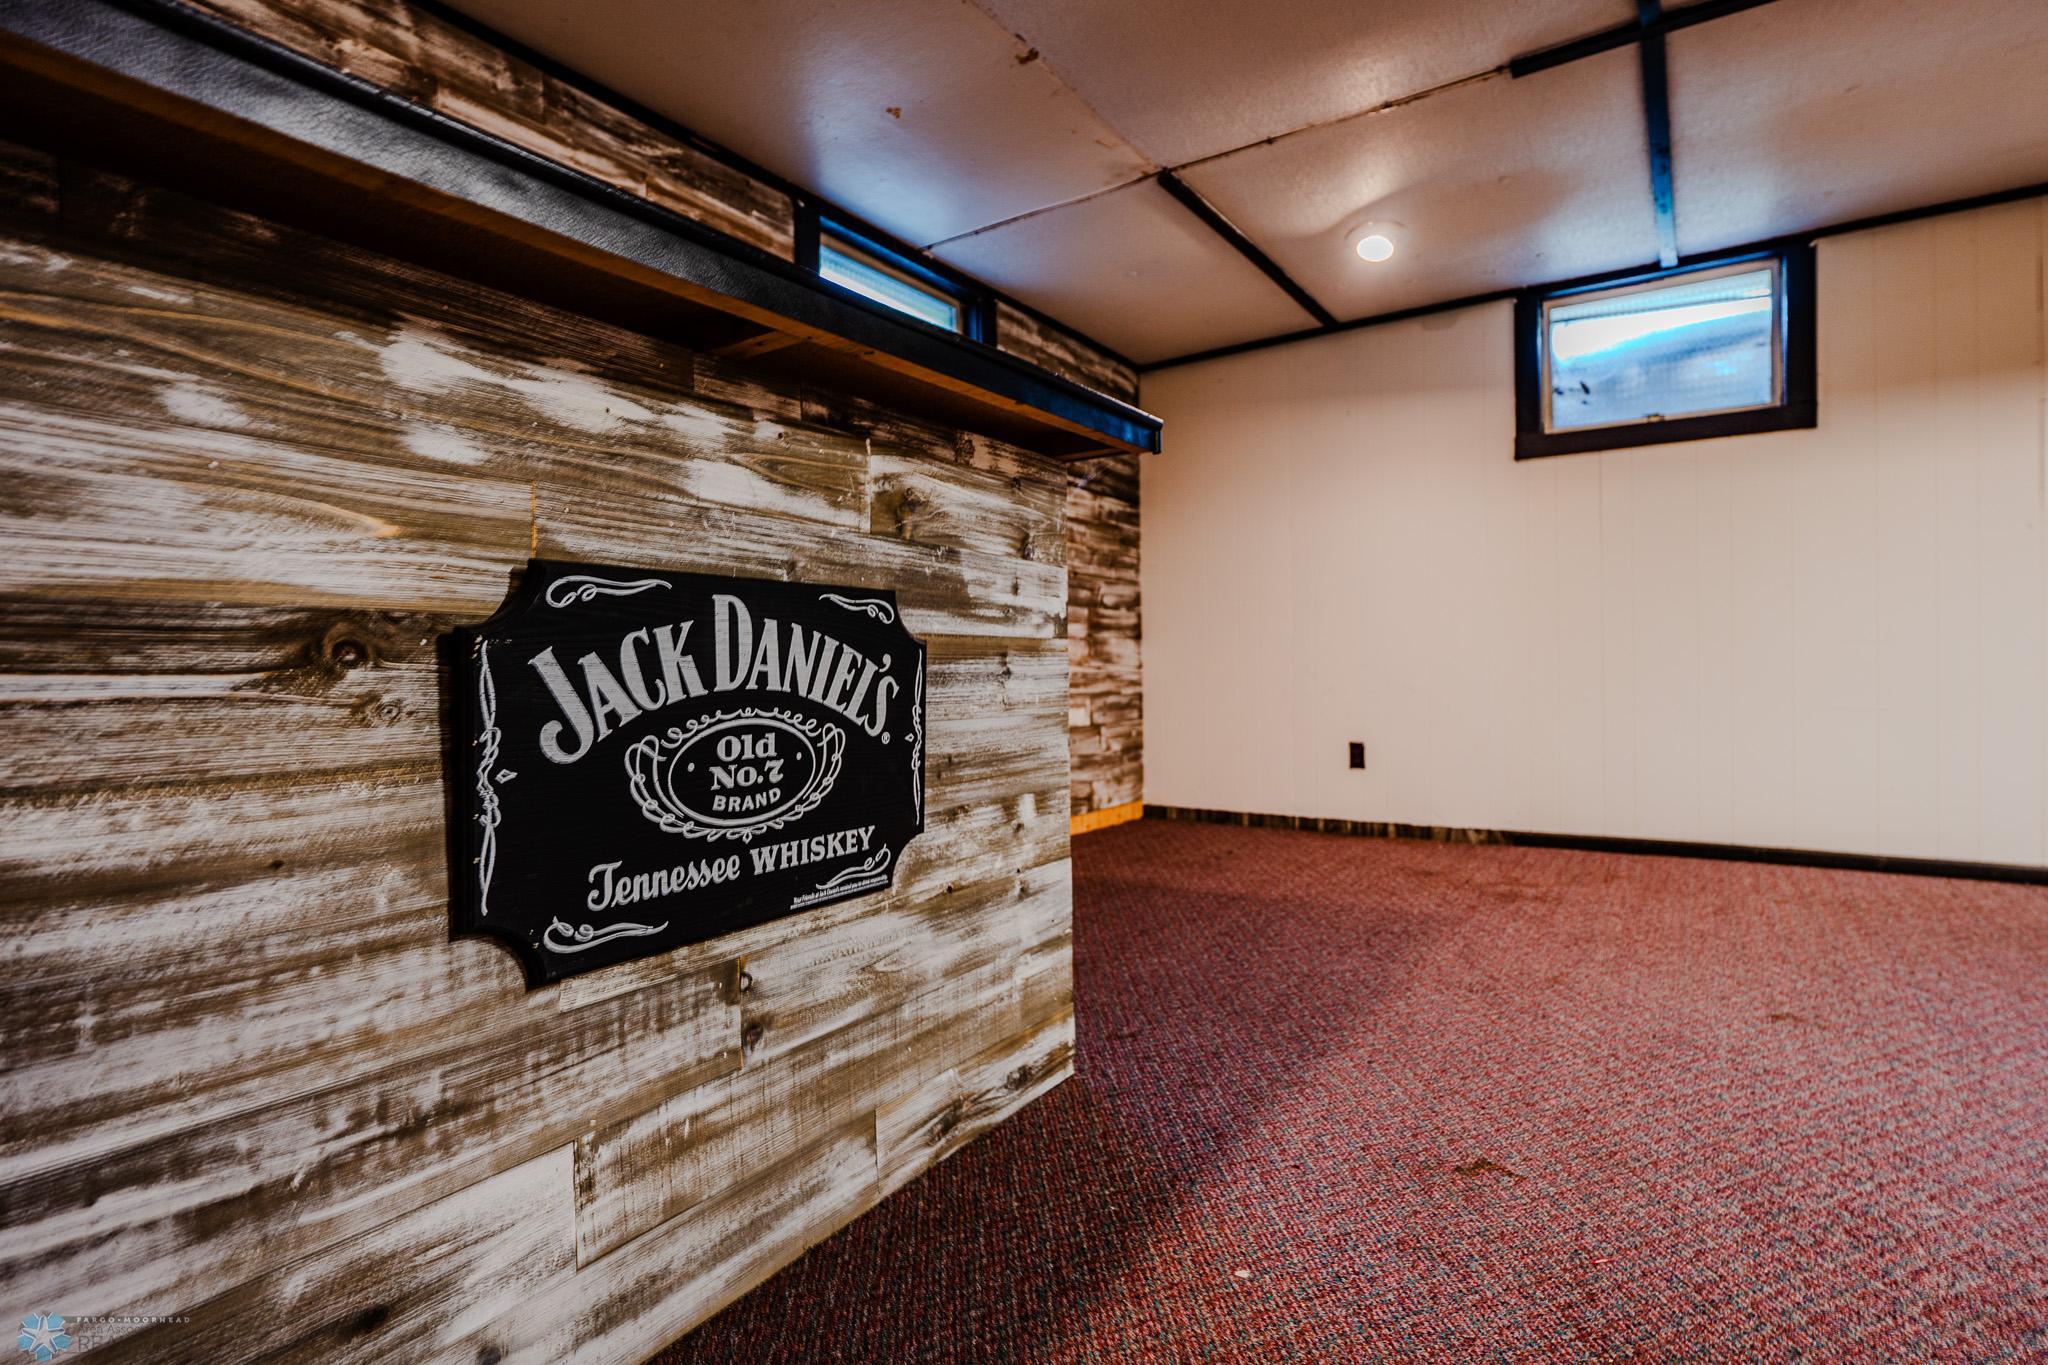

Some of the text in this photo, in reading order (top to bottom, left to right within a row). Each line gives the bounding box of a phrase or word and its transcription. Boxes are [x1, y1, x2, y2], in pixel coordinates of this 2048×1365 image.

[527, 620, 708, 765] JACK
[716, 732, 777, 762] Old
[712, 788, 781, 812] BRAND
[587, 860, 741, 911] Tennessee
[750, 825, 876, 876] WHISKEY
